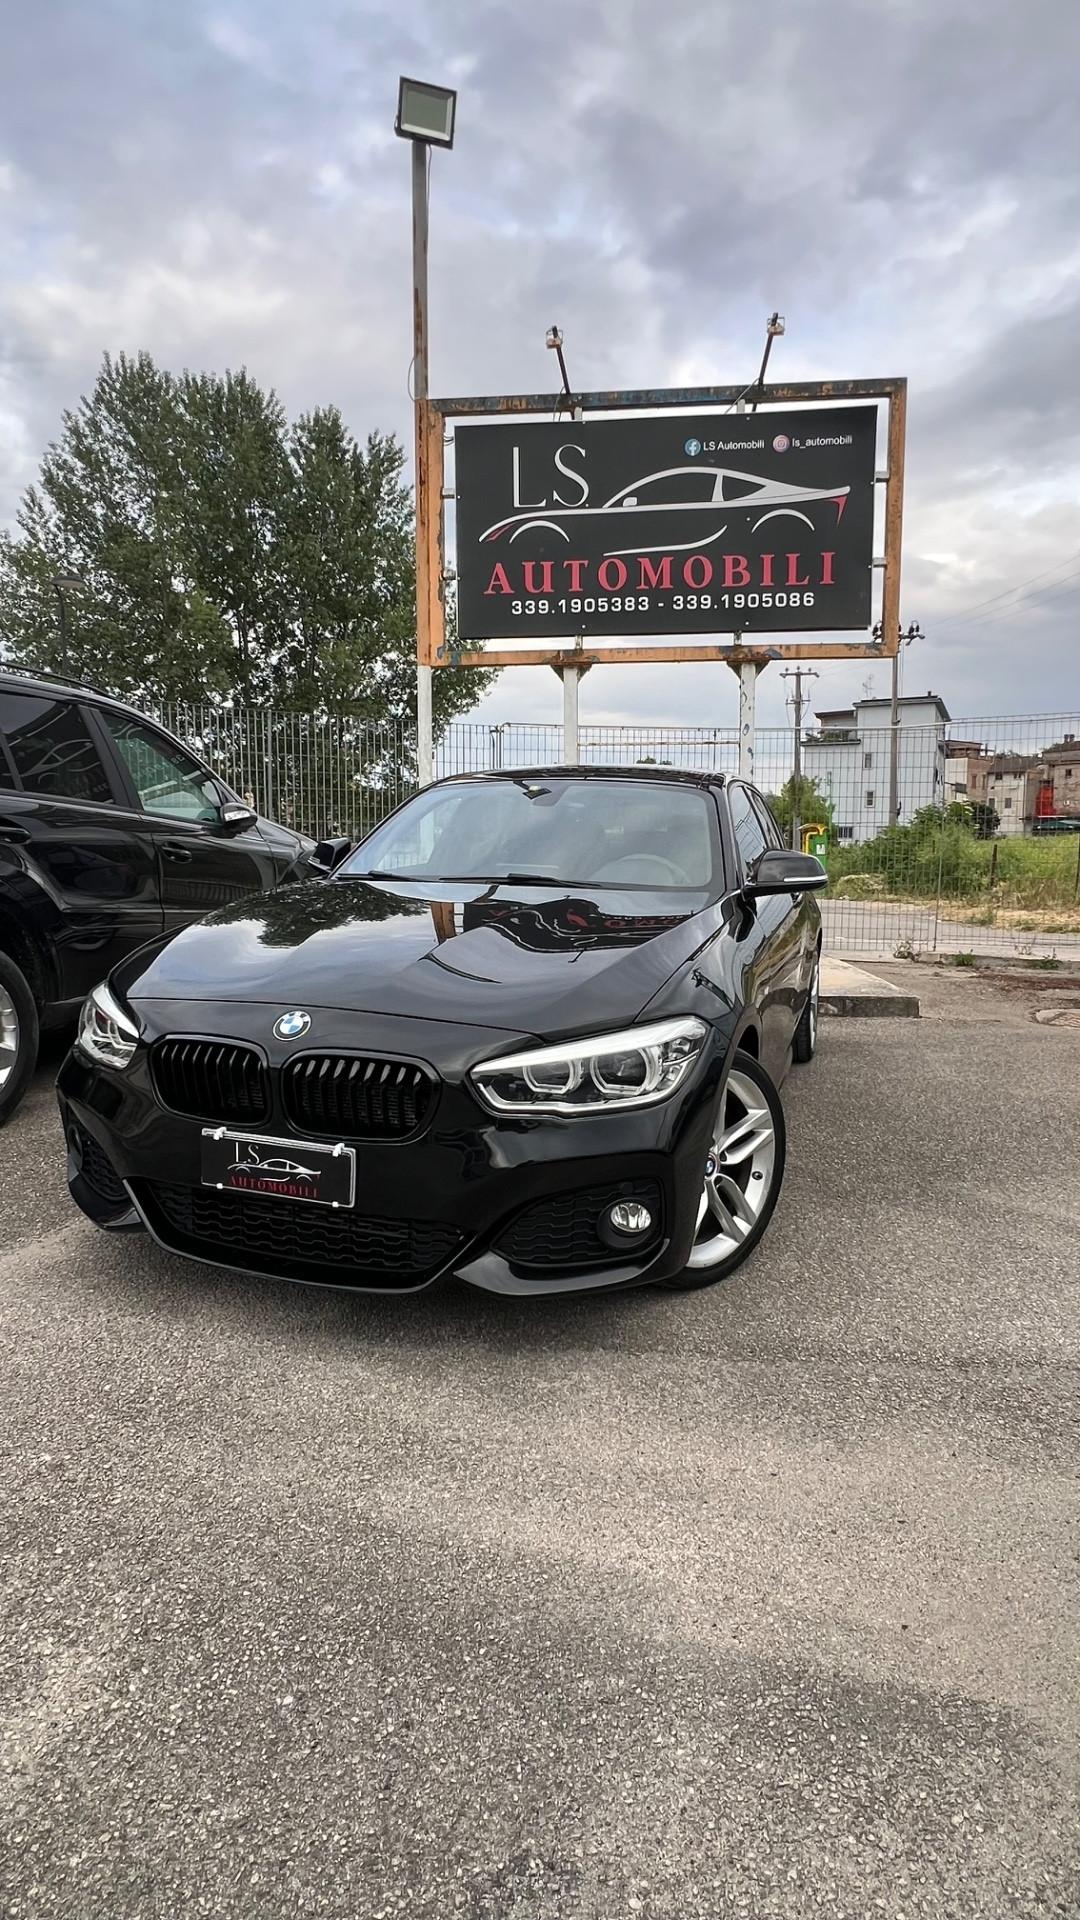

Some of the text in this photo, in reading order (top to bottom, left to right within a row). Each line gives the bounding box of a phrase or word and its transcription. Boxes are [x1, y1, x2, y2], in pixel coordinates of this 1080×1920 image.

[703, 439, 765, 451] LS Automobili
[792, 435, 853, 449] ls_automobili
[484, 552, 836, 595] AUTOMOBILI
[511, 597, 650, 615] 339.1905383
[672, 592, 815, 610] 339.1905086
[229, 1175, 318, 1198] AUTOMOBILI
